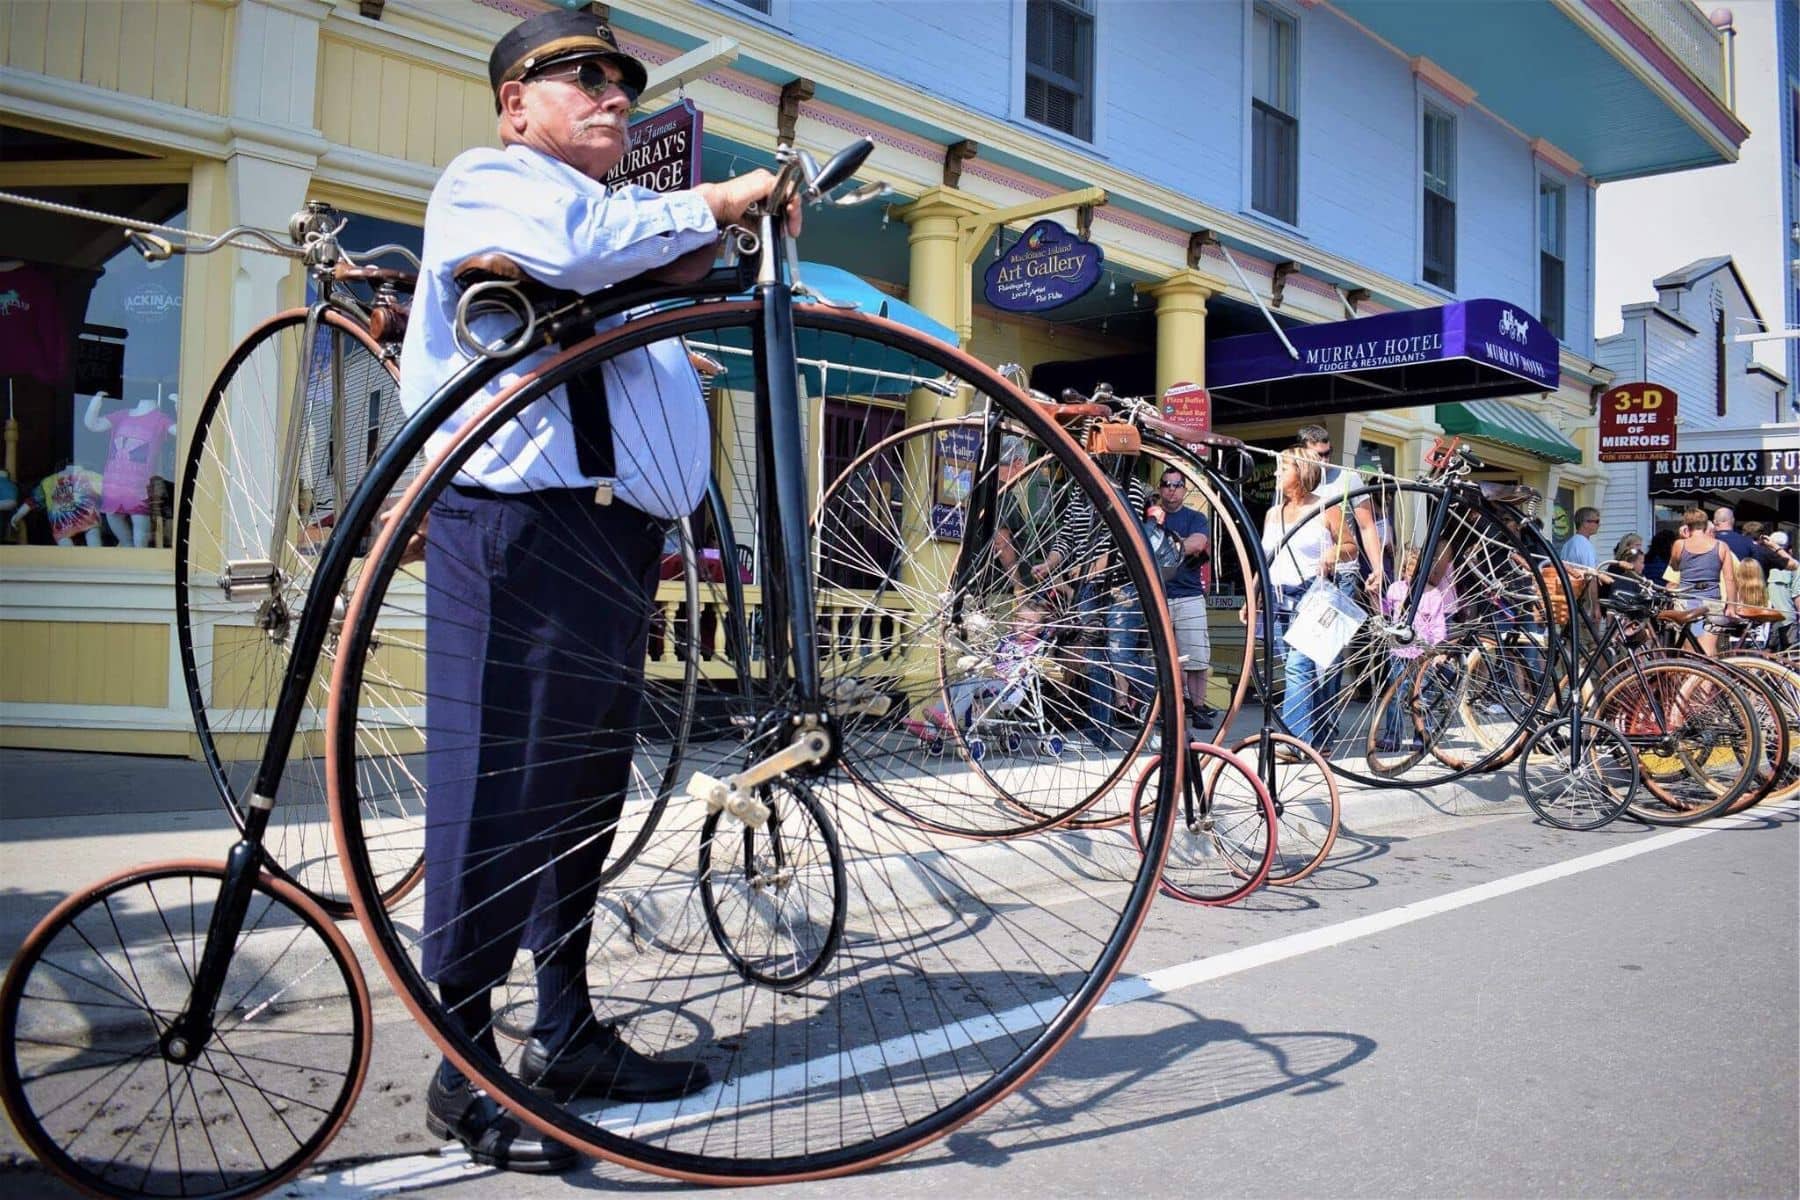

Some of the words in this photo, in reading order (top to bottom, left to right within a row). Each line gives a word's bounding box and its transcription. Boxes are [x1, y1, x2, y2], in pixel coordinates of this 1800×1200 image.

[643, 120, 677, 145] Famous
[606, 130, 686, 181] MURRAY'S
[1010, 250, 1046, 263] Mackinac
[1048, 243, 1073, 256] Island
[996, 264, 1022, 283] Art
[1027, 255, 1087, 278] Gallery
[1306, 341, 1379, 364] MURRAY
[1385, 333, 1442, 355] HOTEL
[1318, 363, 1349, 371] FUDGE
[1361, 352, 1426, 367] RESTAURANTS
[1485, 341, 1520, 368] MURRAY
[1520, 355, 1545, 378] HOTEL
[1615, 390, 1663, 410] 3-D
[1616, 413, 1657, 424] MAZE
[1602, 435, 1670, 447] MIRRORS
[1655, 452, 1757, 474] MURDICKS
[1770, 451, 1800, 470] FU
[1673, 478, 1693, 488] THE
[1755, 475, 1787, 486] SINCE
